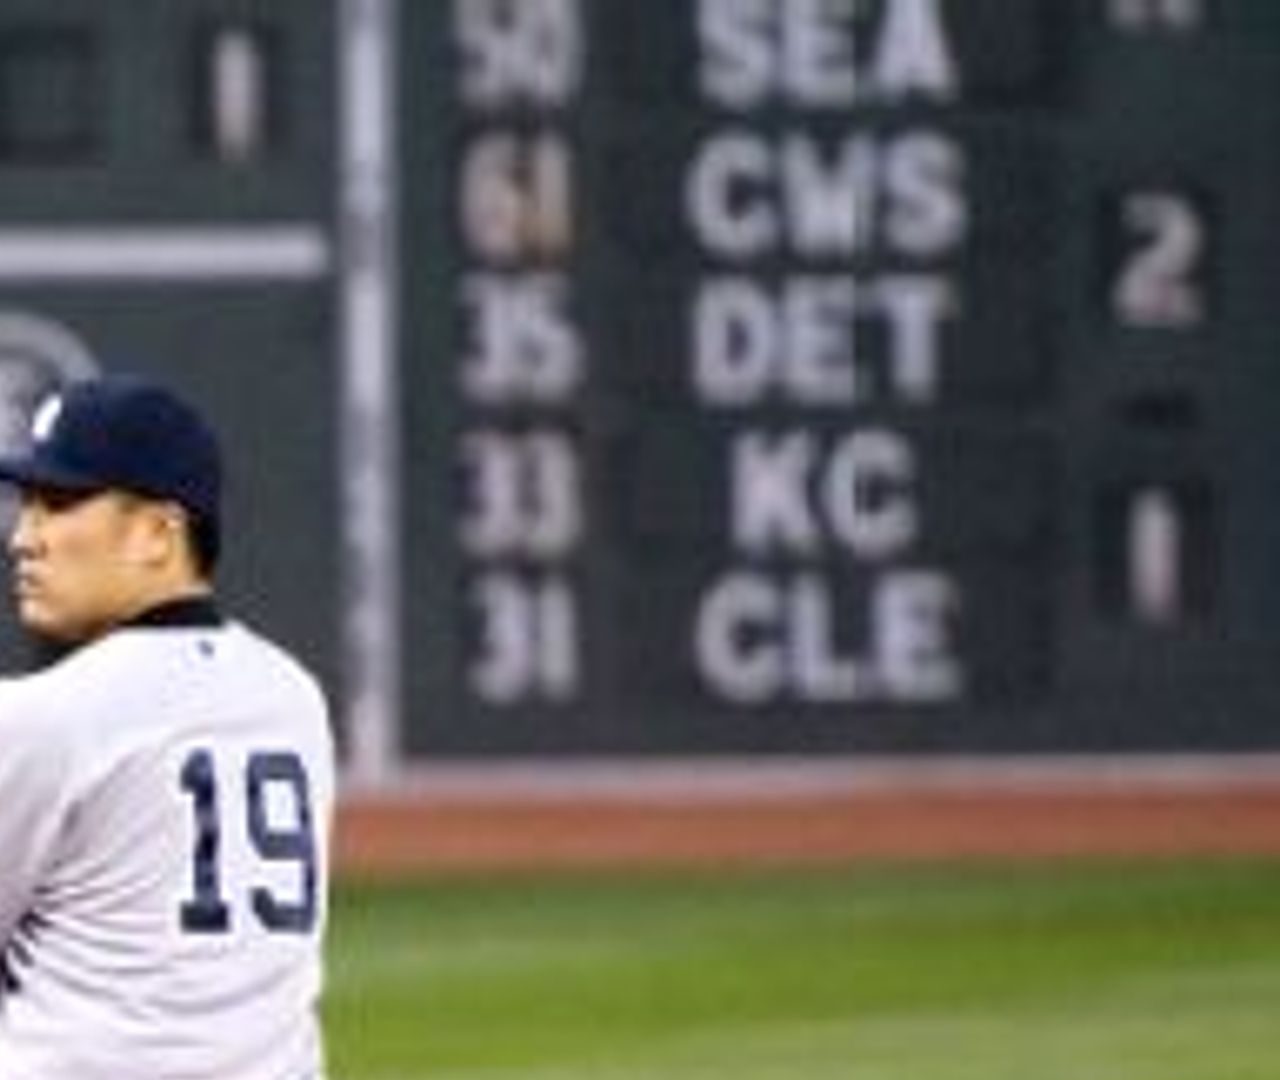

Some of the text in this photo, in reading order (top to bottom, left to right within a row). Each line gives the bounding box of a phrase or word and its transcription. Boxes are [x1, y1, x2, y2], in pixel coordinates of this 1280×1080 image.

[696, 0, 956, 106] SEA
[687, 133, 965, 256] CWS
[1113, 195, 1204, 326] 2
[462, 274, 952, 404] 35 DET
[460, 430, 915, 556] 33 KC
[472, 572, 957, 702] 31 CLE
[178, 747, 318, 934] 19
